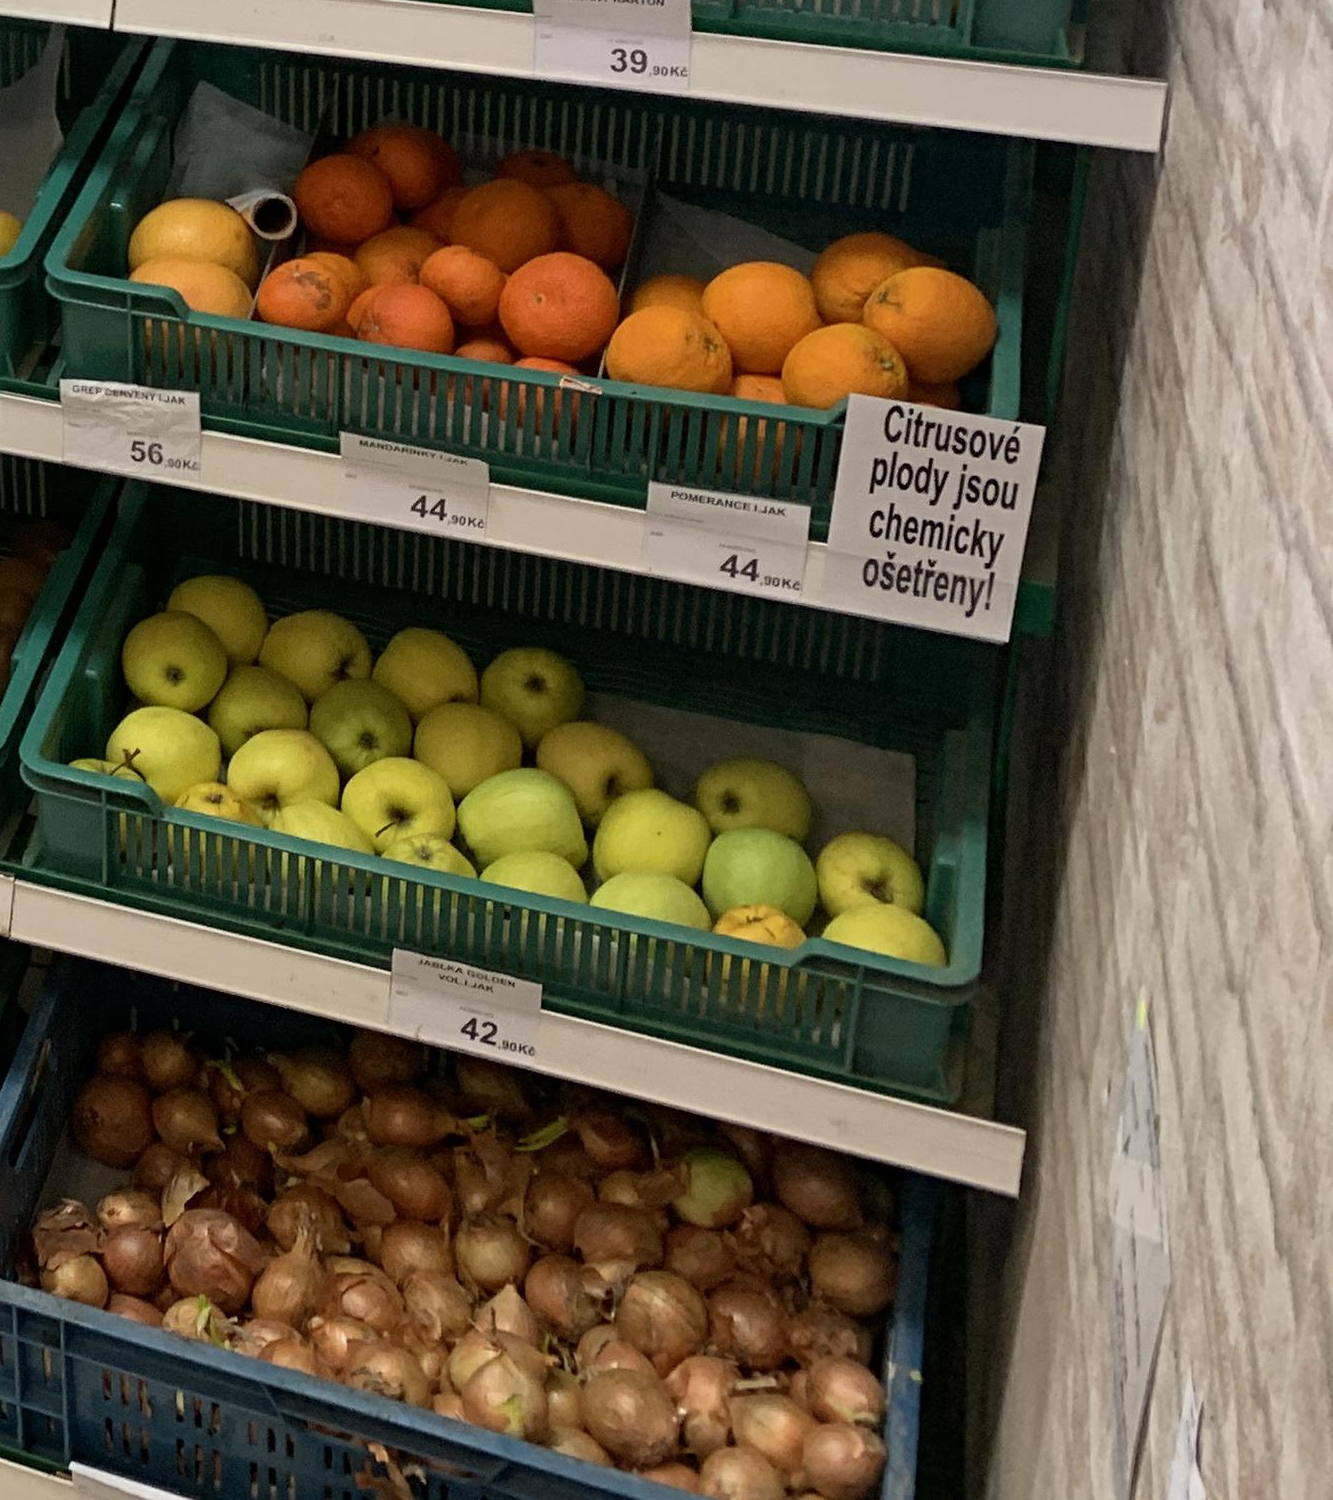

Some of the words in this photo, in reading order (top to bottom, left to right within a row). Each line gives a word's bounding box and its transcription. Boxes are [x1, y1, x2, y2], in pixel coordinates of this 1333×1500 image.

[71, 382, 104, 398] GREP
[358, 438, 437, 460] MANDARINKY
[883, 404, 1022, 465] Citrusové
[670, 490, 752, 512] POMERANCE
[868, 450, 950, 507] plody
[952, 463, 1019, 511] jsou
[869, 502, 1005, 570] chemicky
[862, 550, 996, 619] ošetřeny!
[417, 958, 464, 975] JABLKA
[466, 967, 517, 989] GOLDEN
